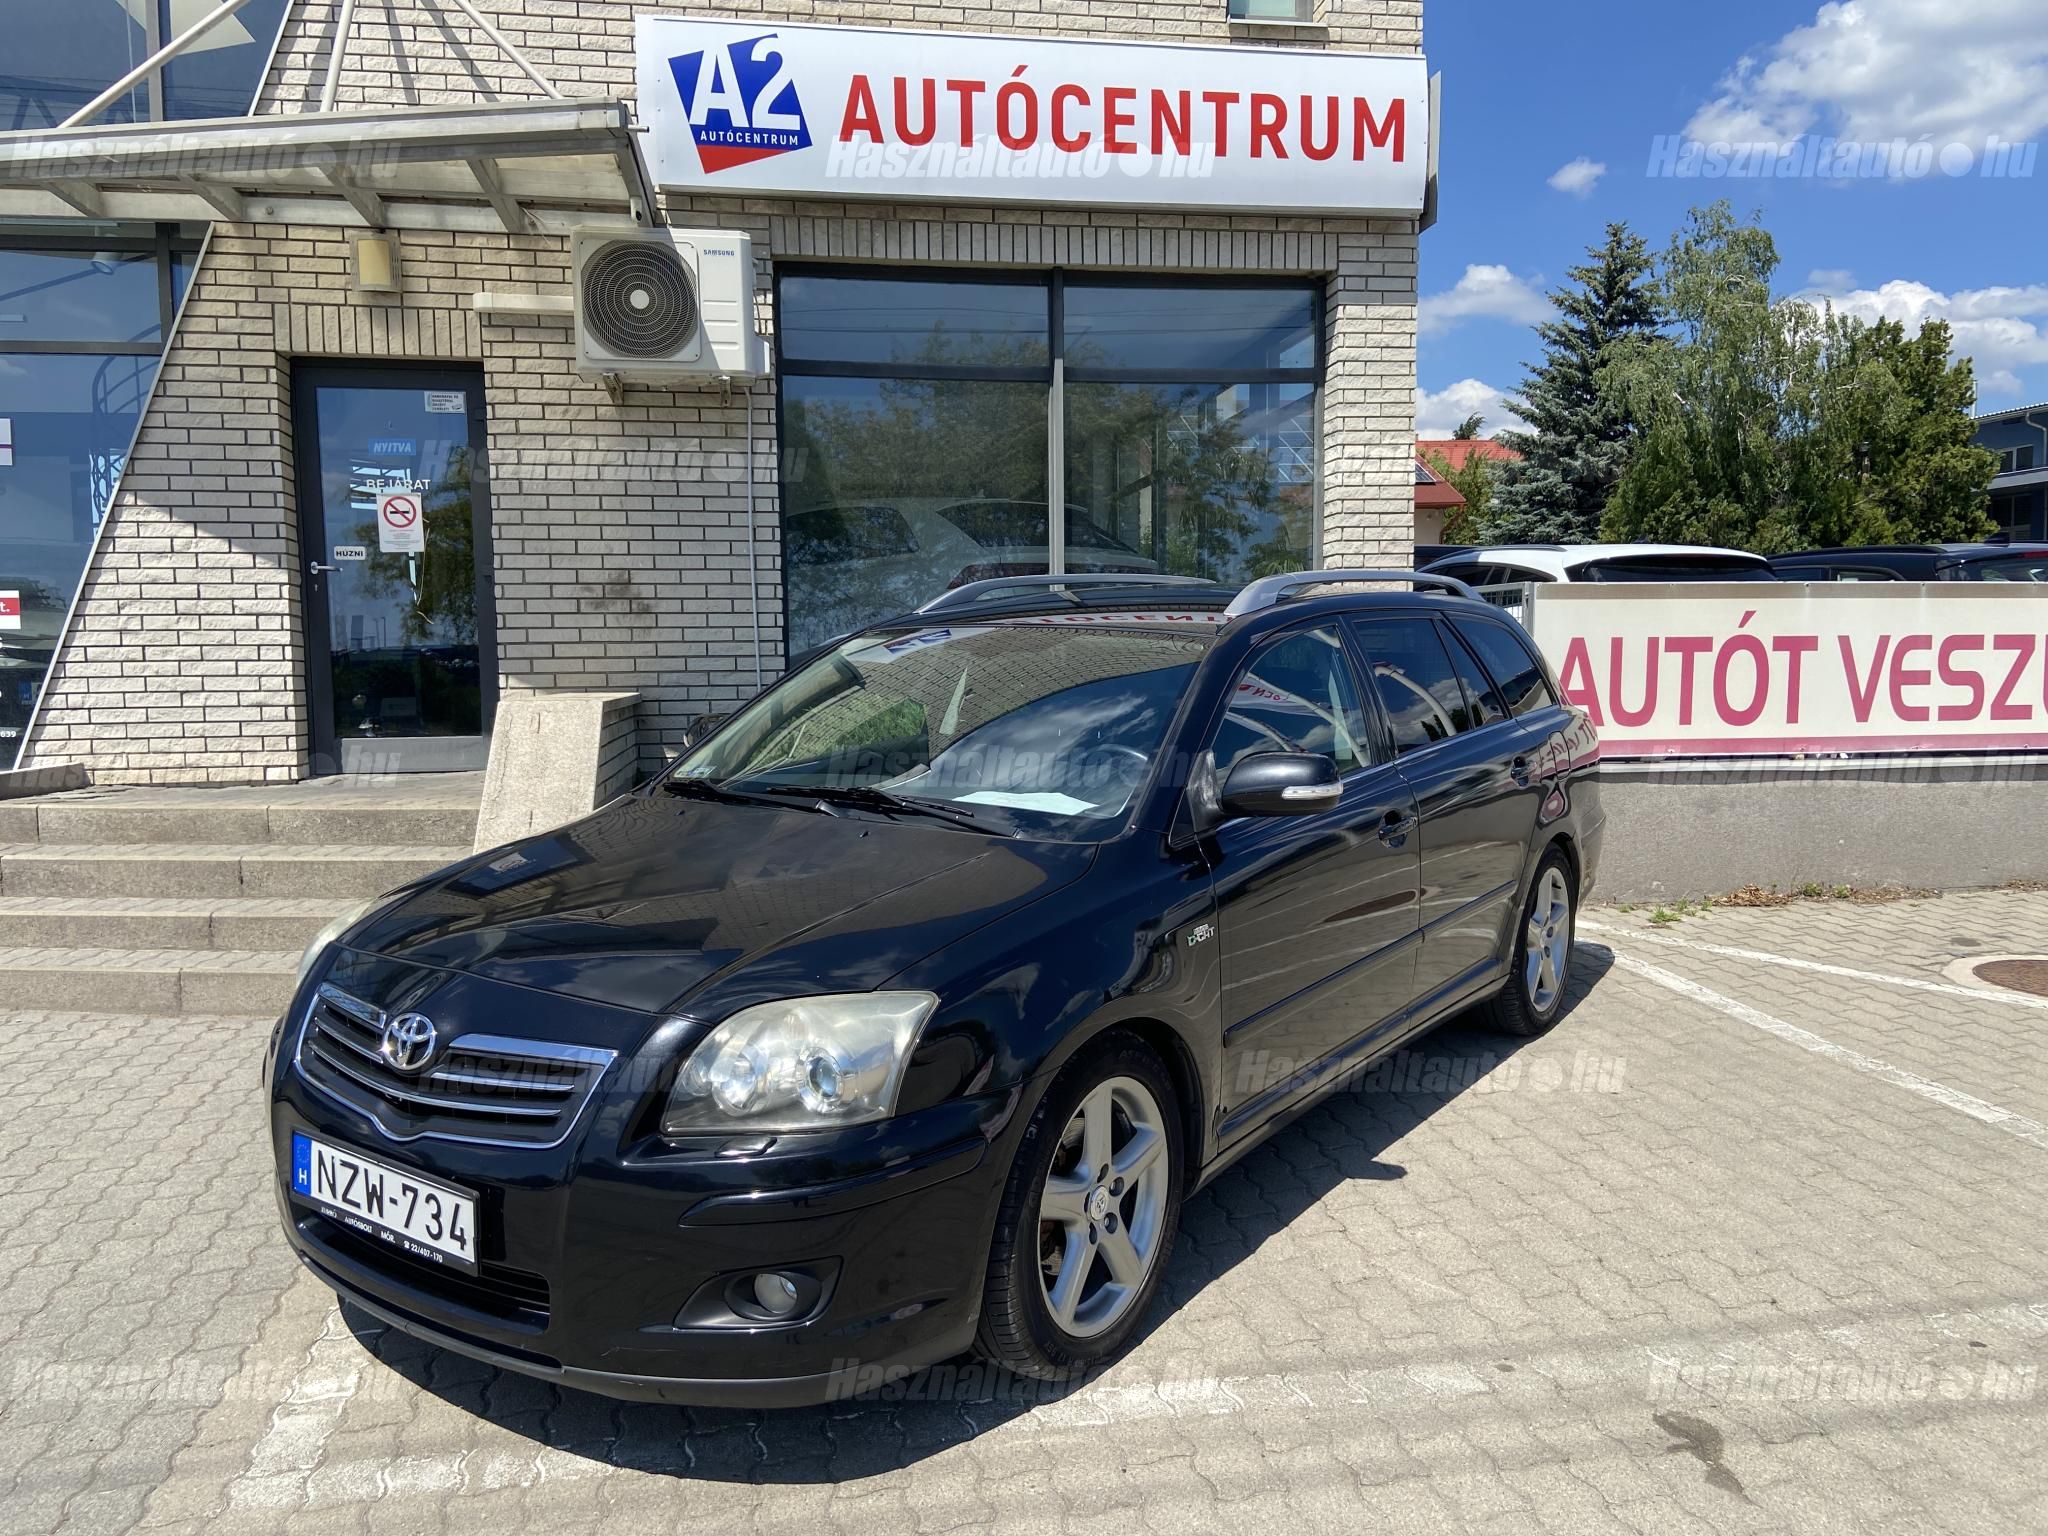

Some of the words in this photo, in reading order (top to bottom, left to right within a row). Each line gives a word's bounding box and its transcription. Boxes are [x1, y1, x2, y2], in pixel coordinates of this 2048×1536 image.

[689, 31, 801, 131] A2
[839, 64, 1406, 163] AUTÓCENTRUM
[700, 129, 799, 146] AUTÓCENTRUM
[373, 442, 412, 453] NYITVA
[366, 476, 431, 490] BEJÁRAT
[336, 548, 364, 557] HÚZNI
[1560, 610, 1819, 727] AUTÓT
[1837, 633, 2048, 723] VESZ
[298, 1167, 308, 1185] H
[317, 1148, 467, 1251] NZW-734
